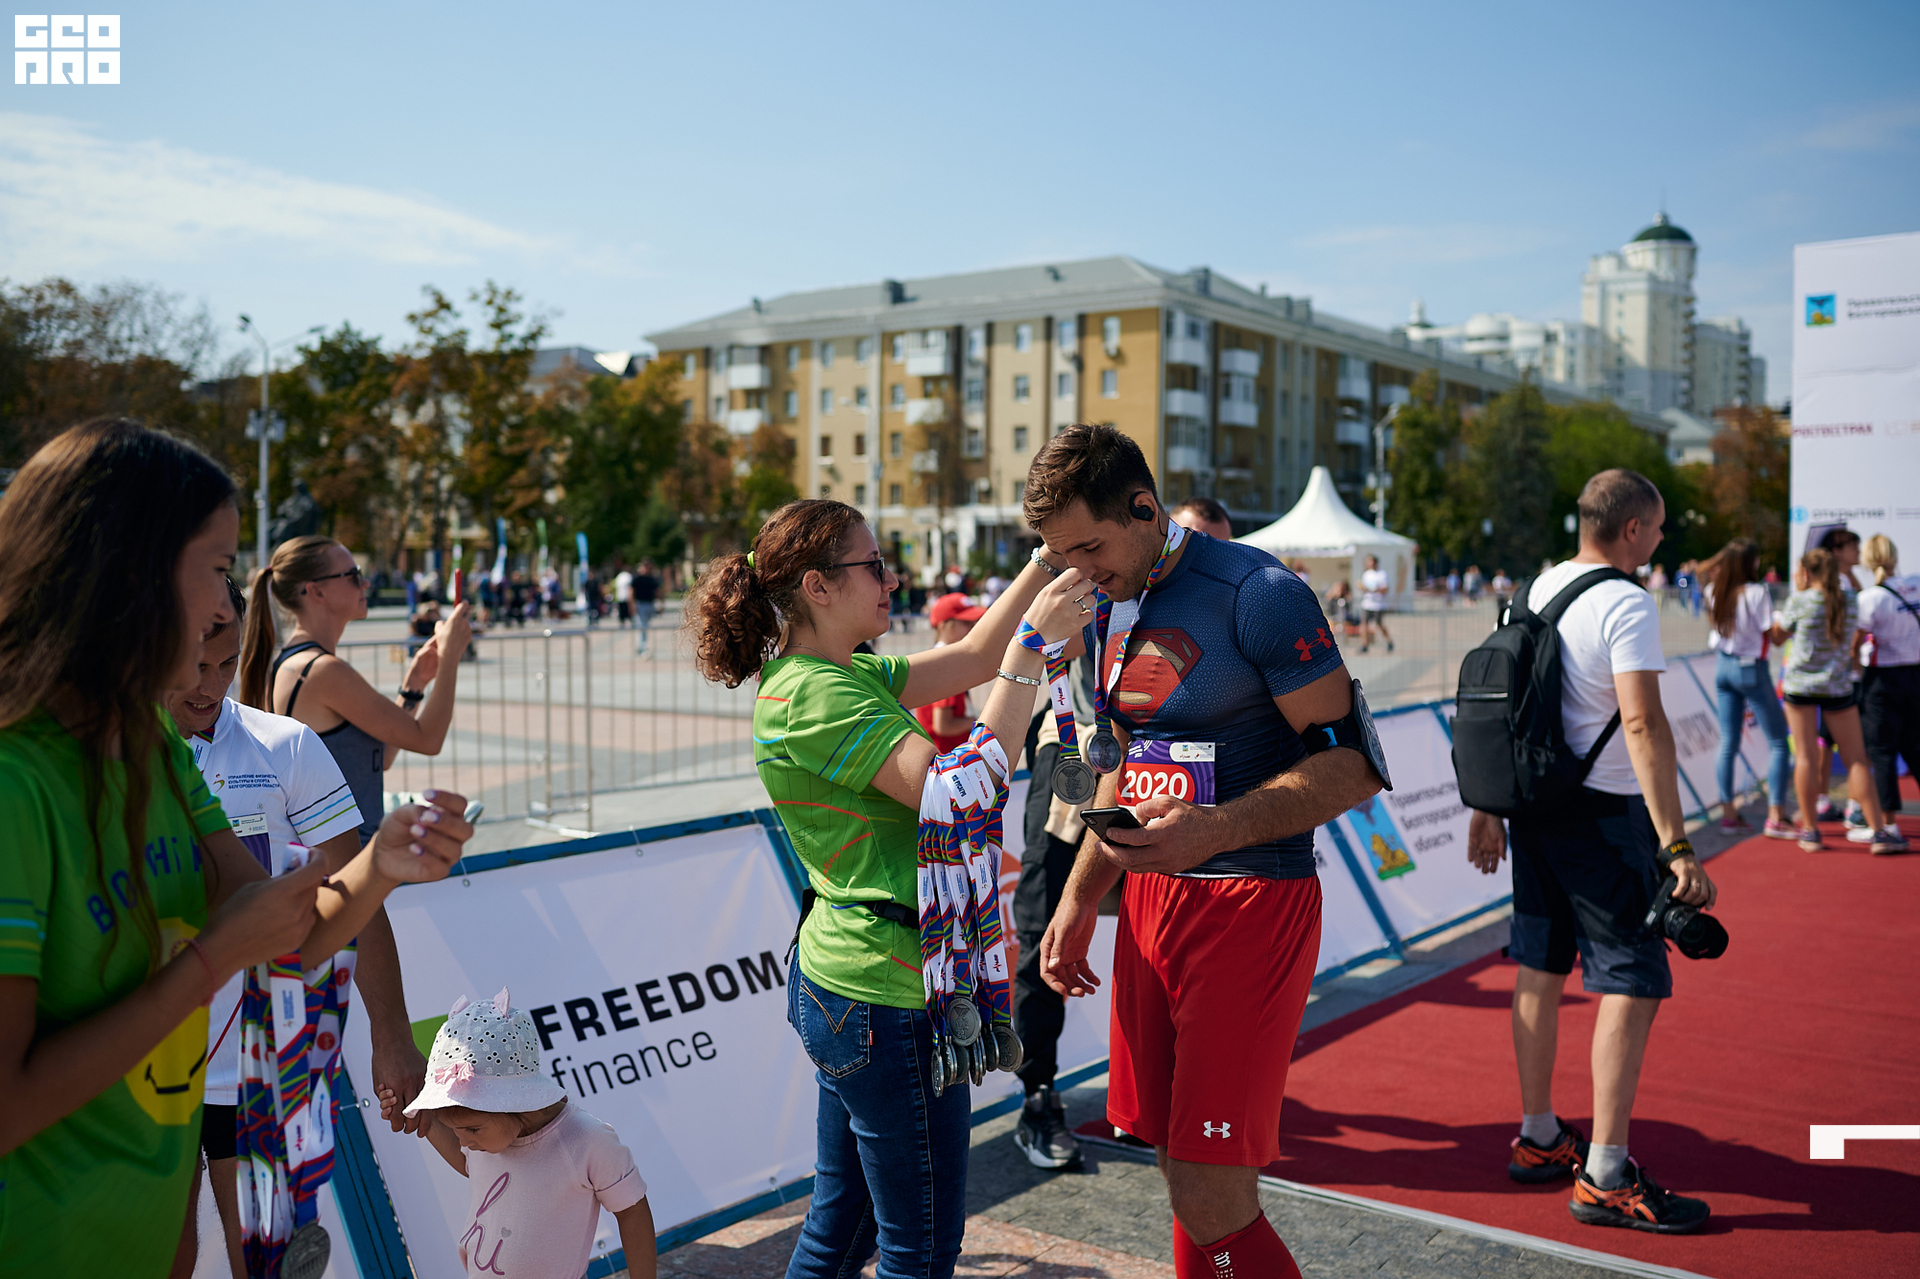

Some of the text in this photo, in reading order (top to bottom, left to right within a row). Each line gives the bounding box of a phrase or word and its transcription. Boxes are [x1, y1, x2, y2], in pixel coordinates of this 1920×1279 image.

[1120, 769, 1188, 800] 2020
[529, 950, 787, 1052] FREEDOM
[551, 1031, 718, 1098] finance
